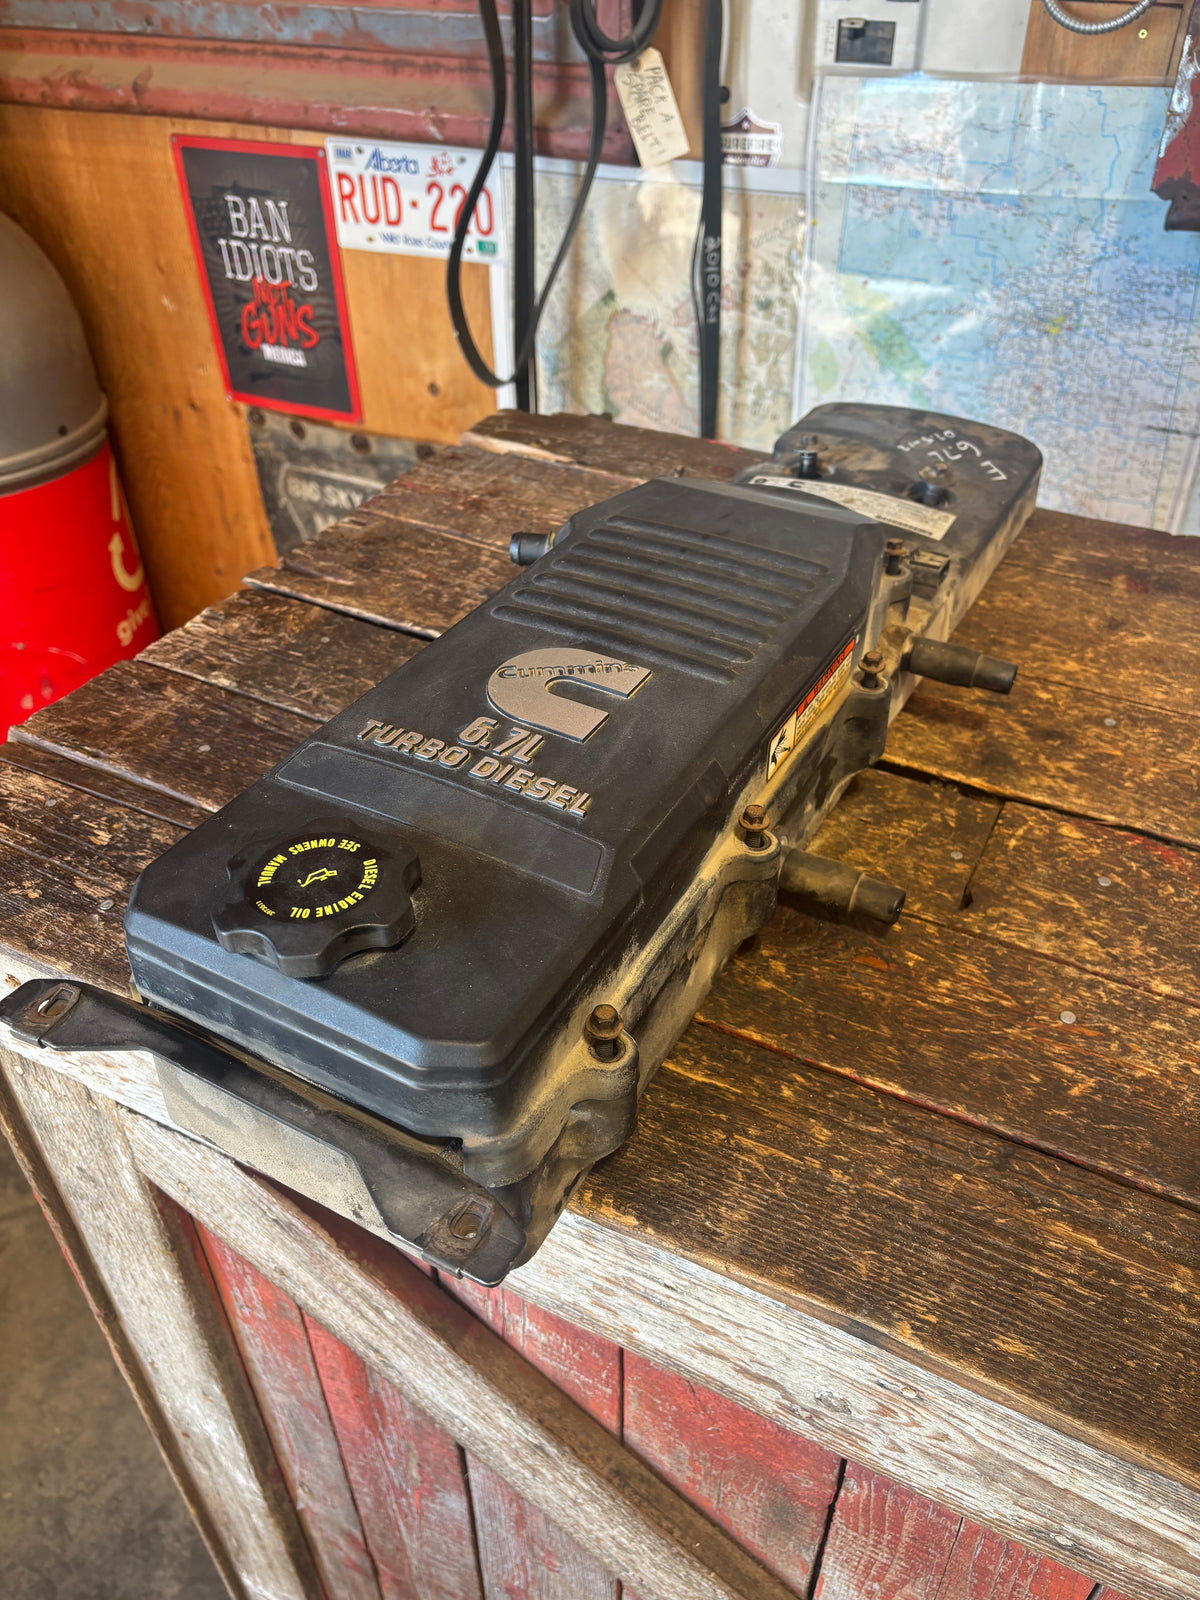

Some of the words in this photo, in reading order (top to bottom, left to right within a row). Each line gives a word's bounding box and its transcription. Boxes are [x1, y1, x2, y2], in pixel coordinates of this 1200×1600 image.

[364, 148, 420, 175] Alberta
[224, 194, 292, 243] BAN
[217, 238, 319, 292] IDIOTS
[241, 302, 319, 349] GUNS
[496, 660, 640, 680] Cummins
[457, 716, 544, 765] 6.7L
[356, 719, 470, 769] TURBO
[468, 756, 591, 818] DIESEL
[288, 838, 335, 855] OWNERS
[338, 839, 361, 852] SEE
[257, 854, 288, 887] MANUAL
[358, 858, 378, 890] DIESEL
[290, 906, 310, 919] OIL
[315, 891, 364, 917] ENGINE
